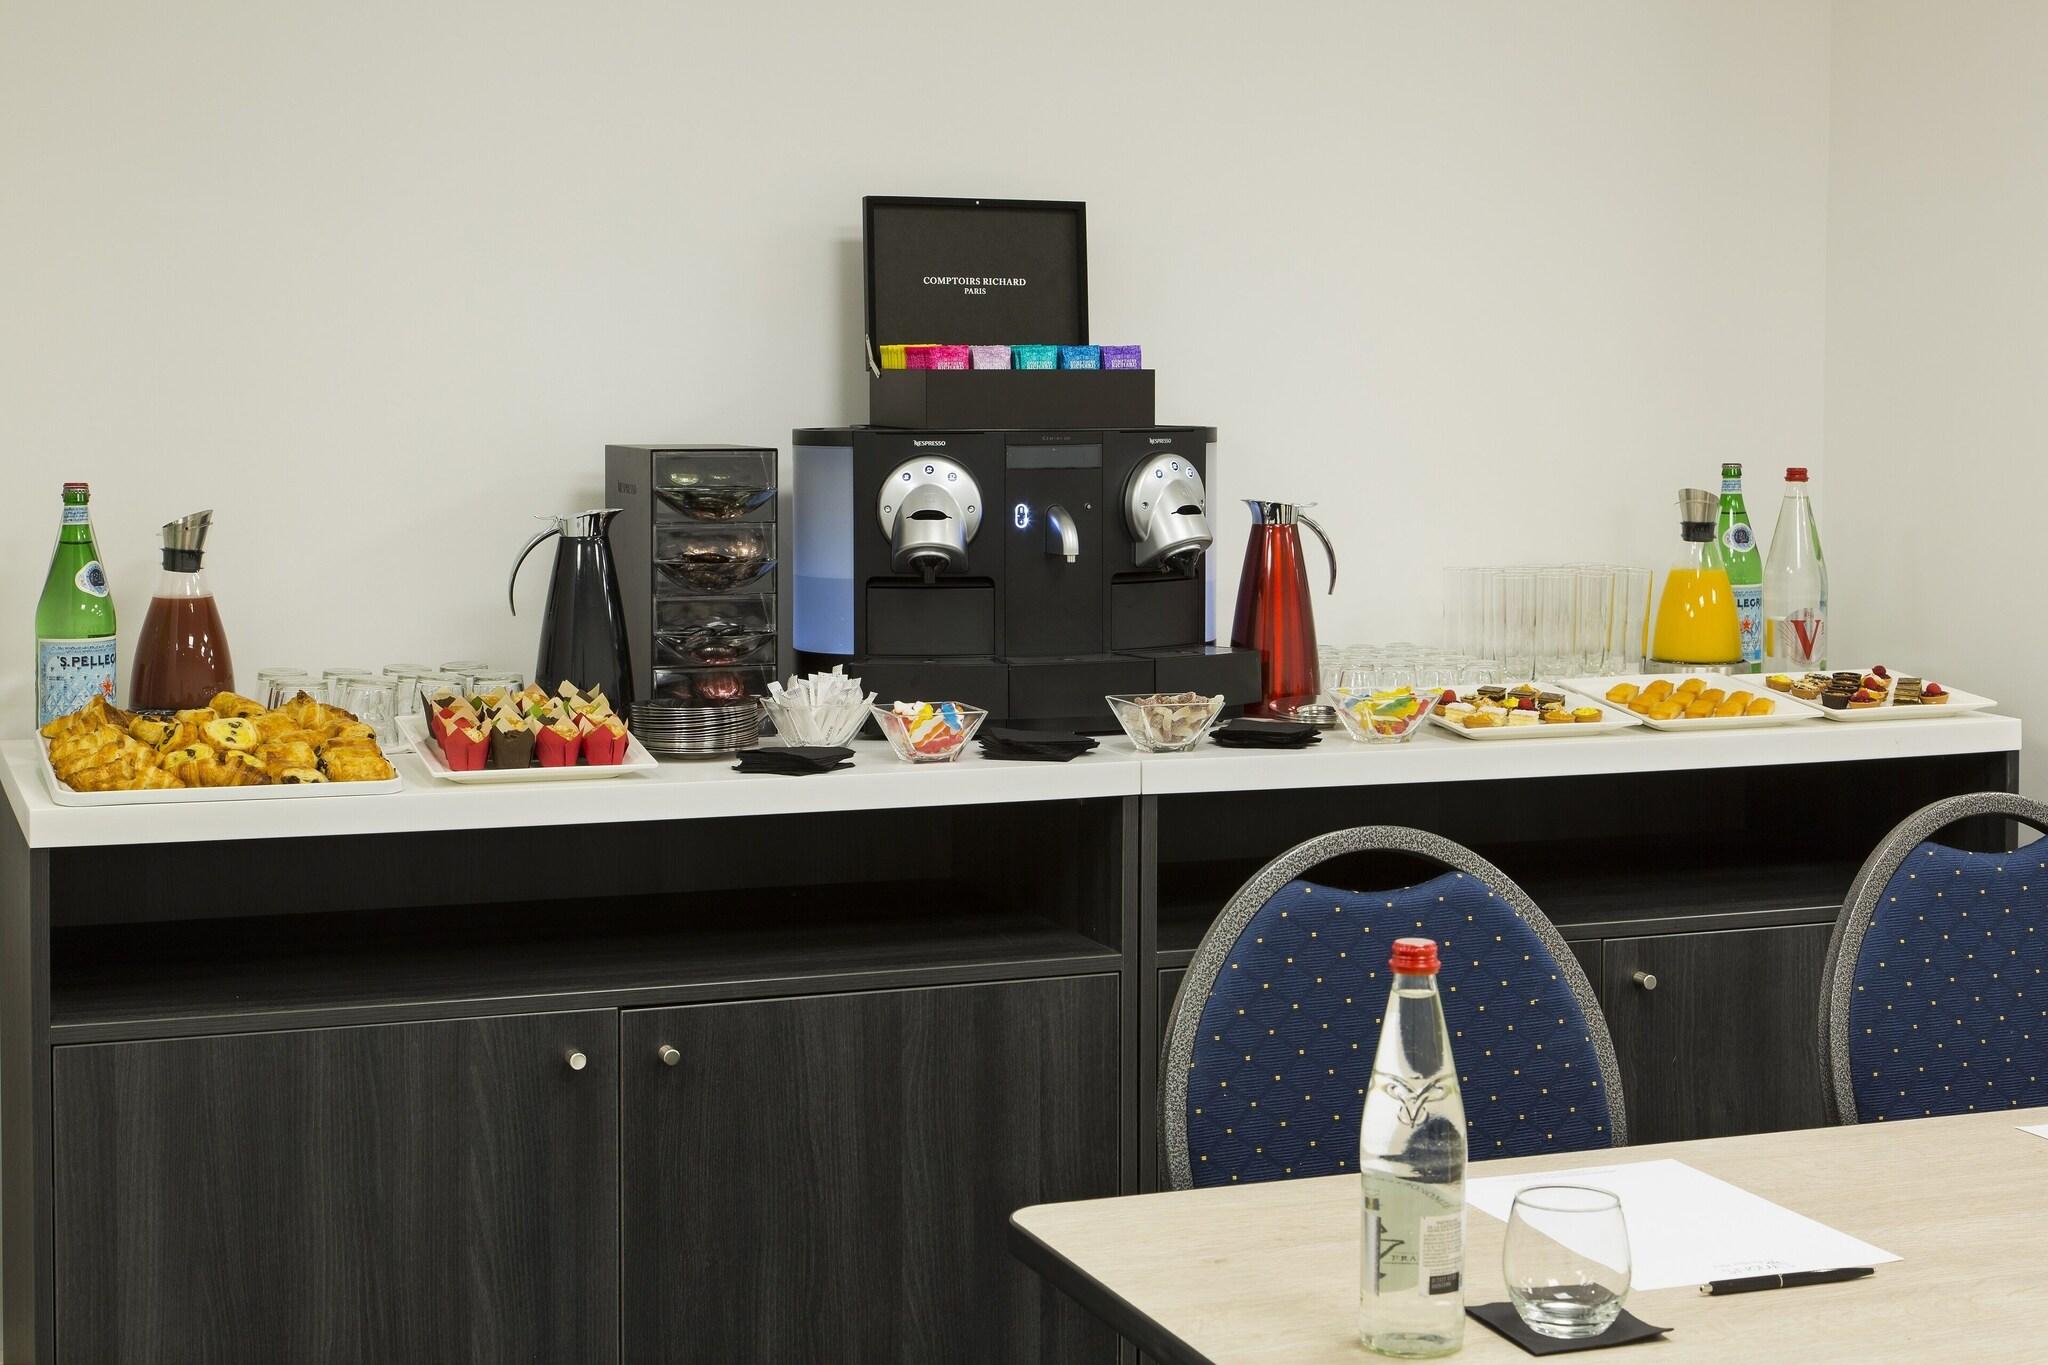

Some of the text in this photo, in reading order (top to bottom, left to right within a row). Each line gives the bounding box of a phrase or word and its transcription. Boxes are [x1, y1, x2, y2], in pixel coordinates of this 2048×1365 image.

[923, 276, 1027, 286] COMPTOIRS RICHARD
[964, 287, 987, 295] PARIS
[913, 439, 946, 447] NESPRESSO
[1149, 437, 1172, 445] NESPRESSO
